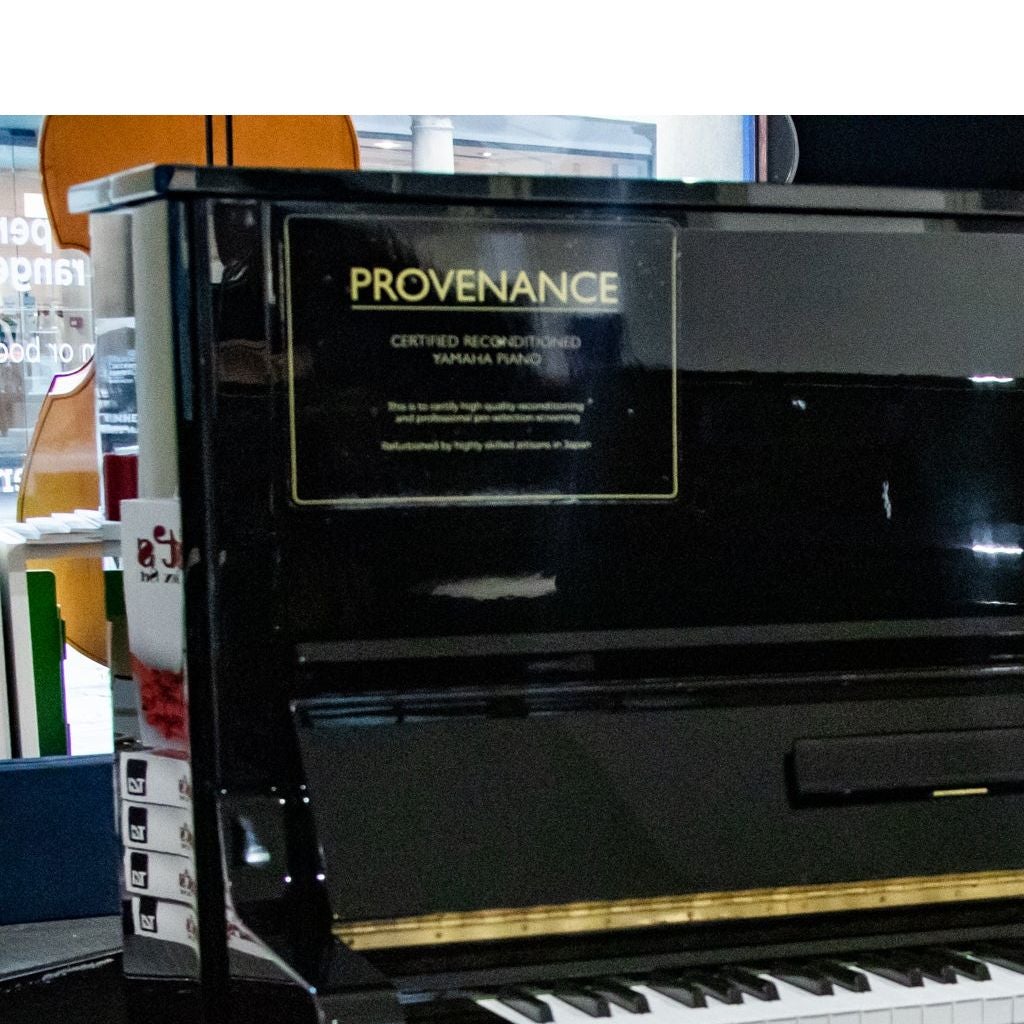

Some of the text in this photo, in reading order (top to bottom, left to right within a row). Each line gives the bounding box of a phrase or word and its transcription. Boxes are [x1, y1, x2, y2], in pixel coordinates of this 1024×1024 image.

[351, 267, 618, 303] PROVENANCE
[389, 334, 583, 350] CERTIFIED RECONDITIONED
[432, 352, 544, 366] YAMAHA PIANO
